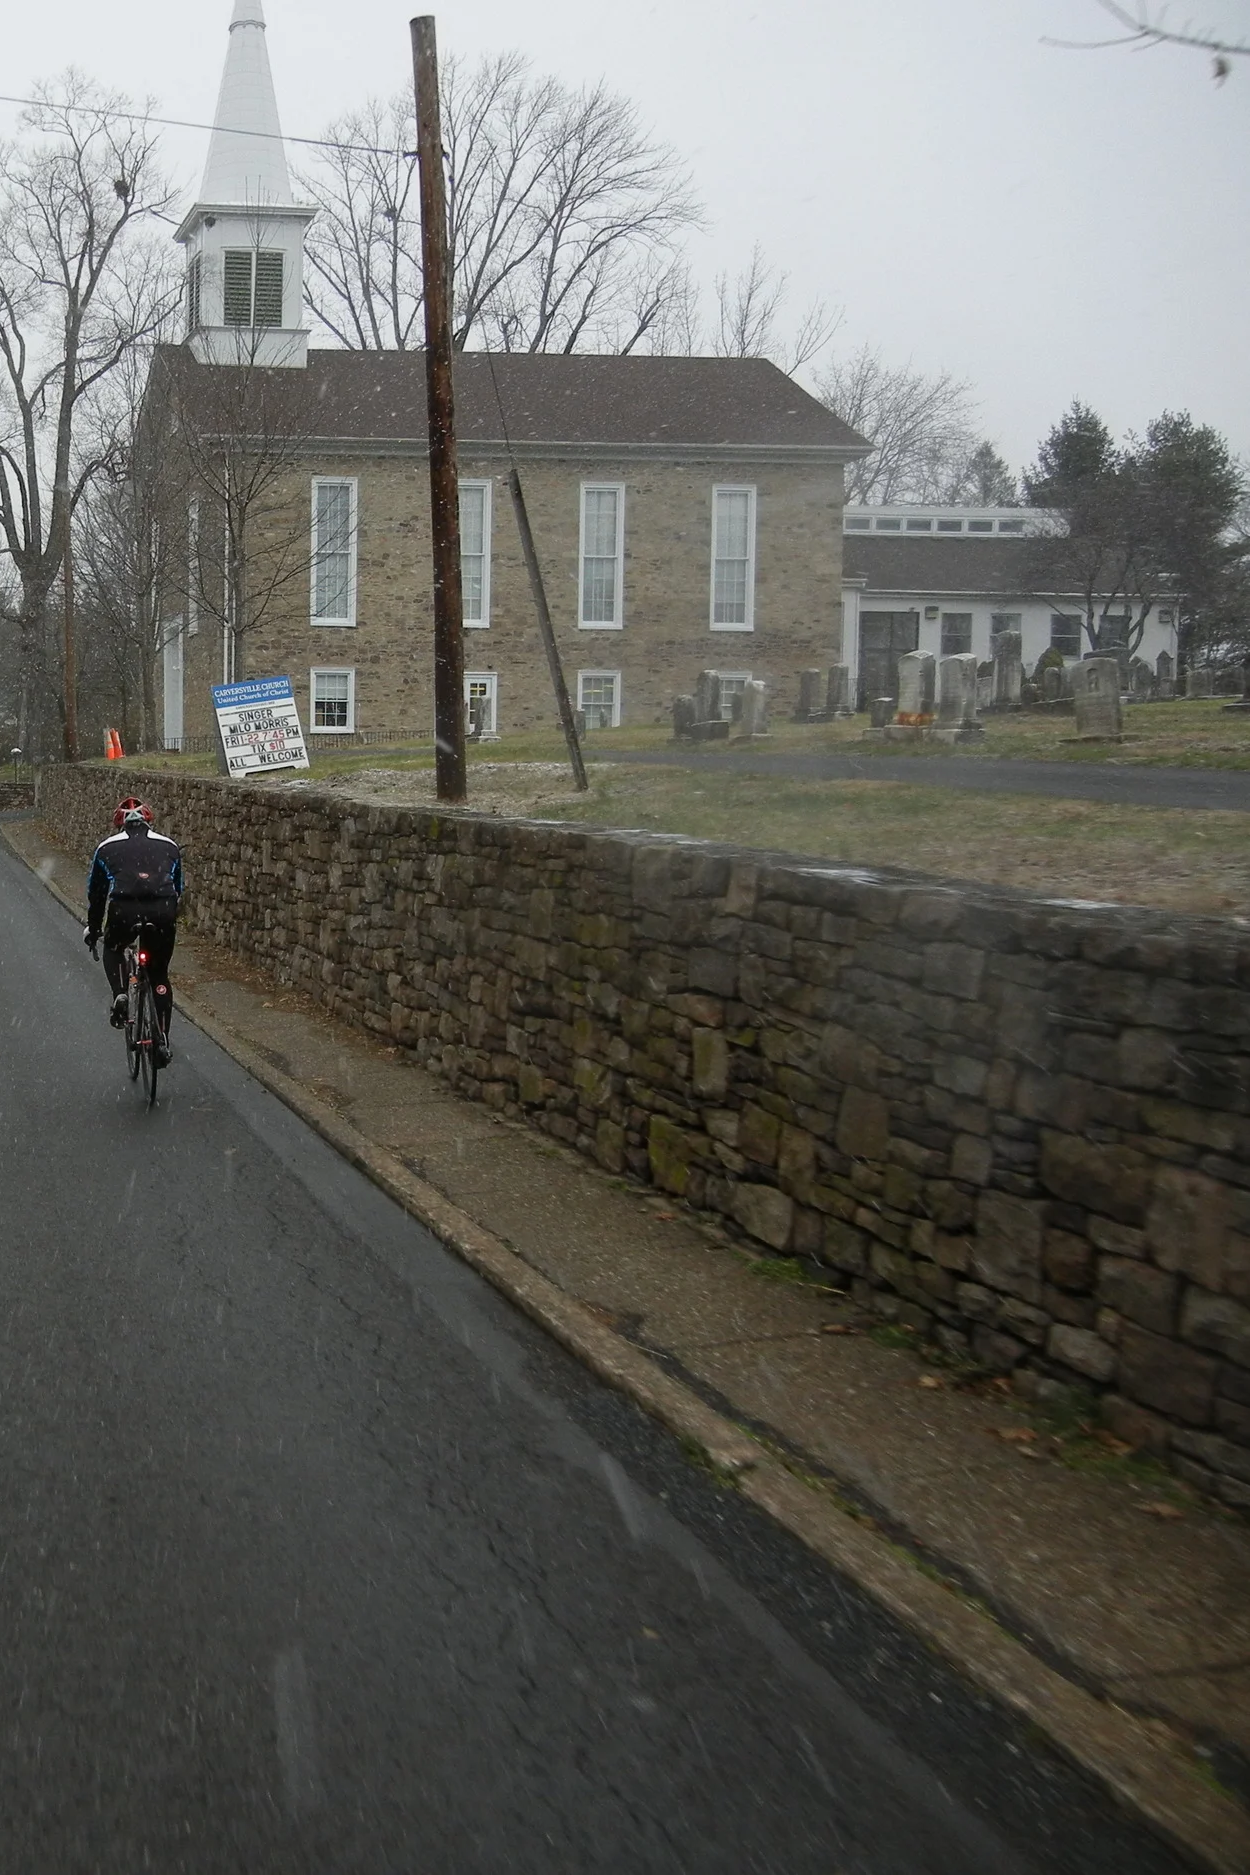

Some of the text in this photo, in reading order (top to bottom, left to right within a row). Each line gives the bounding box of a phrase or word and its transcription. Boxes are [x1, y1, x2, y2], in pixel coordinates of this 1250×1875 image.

[261, 680, 289, 691] CHURCH
[217, 695, 239, 704] United
[239, 692, 262, 701] Church
[269, 688, 289, 696] Christ
[239, 709, 273, 722] SINGER
[229, 717, 289, 735] MILO MORRIS
[286, 728, 299, 737] PM
[251, 740, 286, 753] TIX $10
[230, 749, 304, 768] ALL WELCOME
